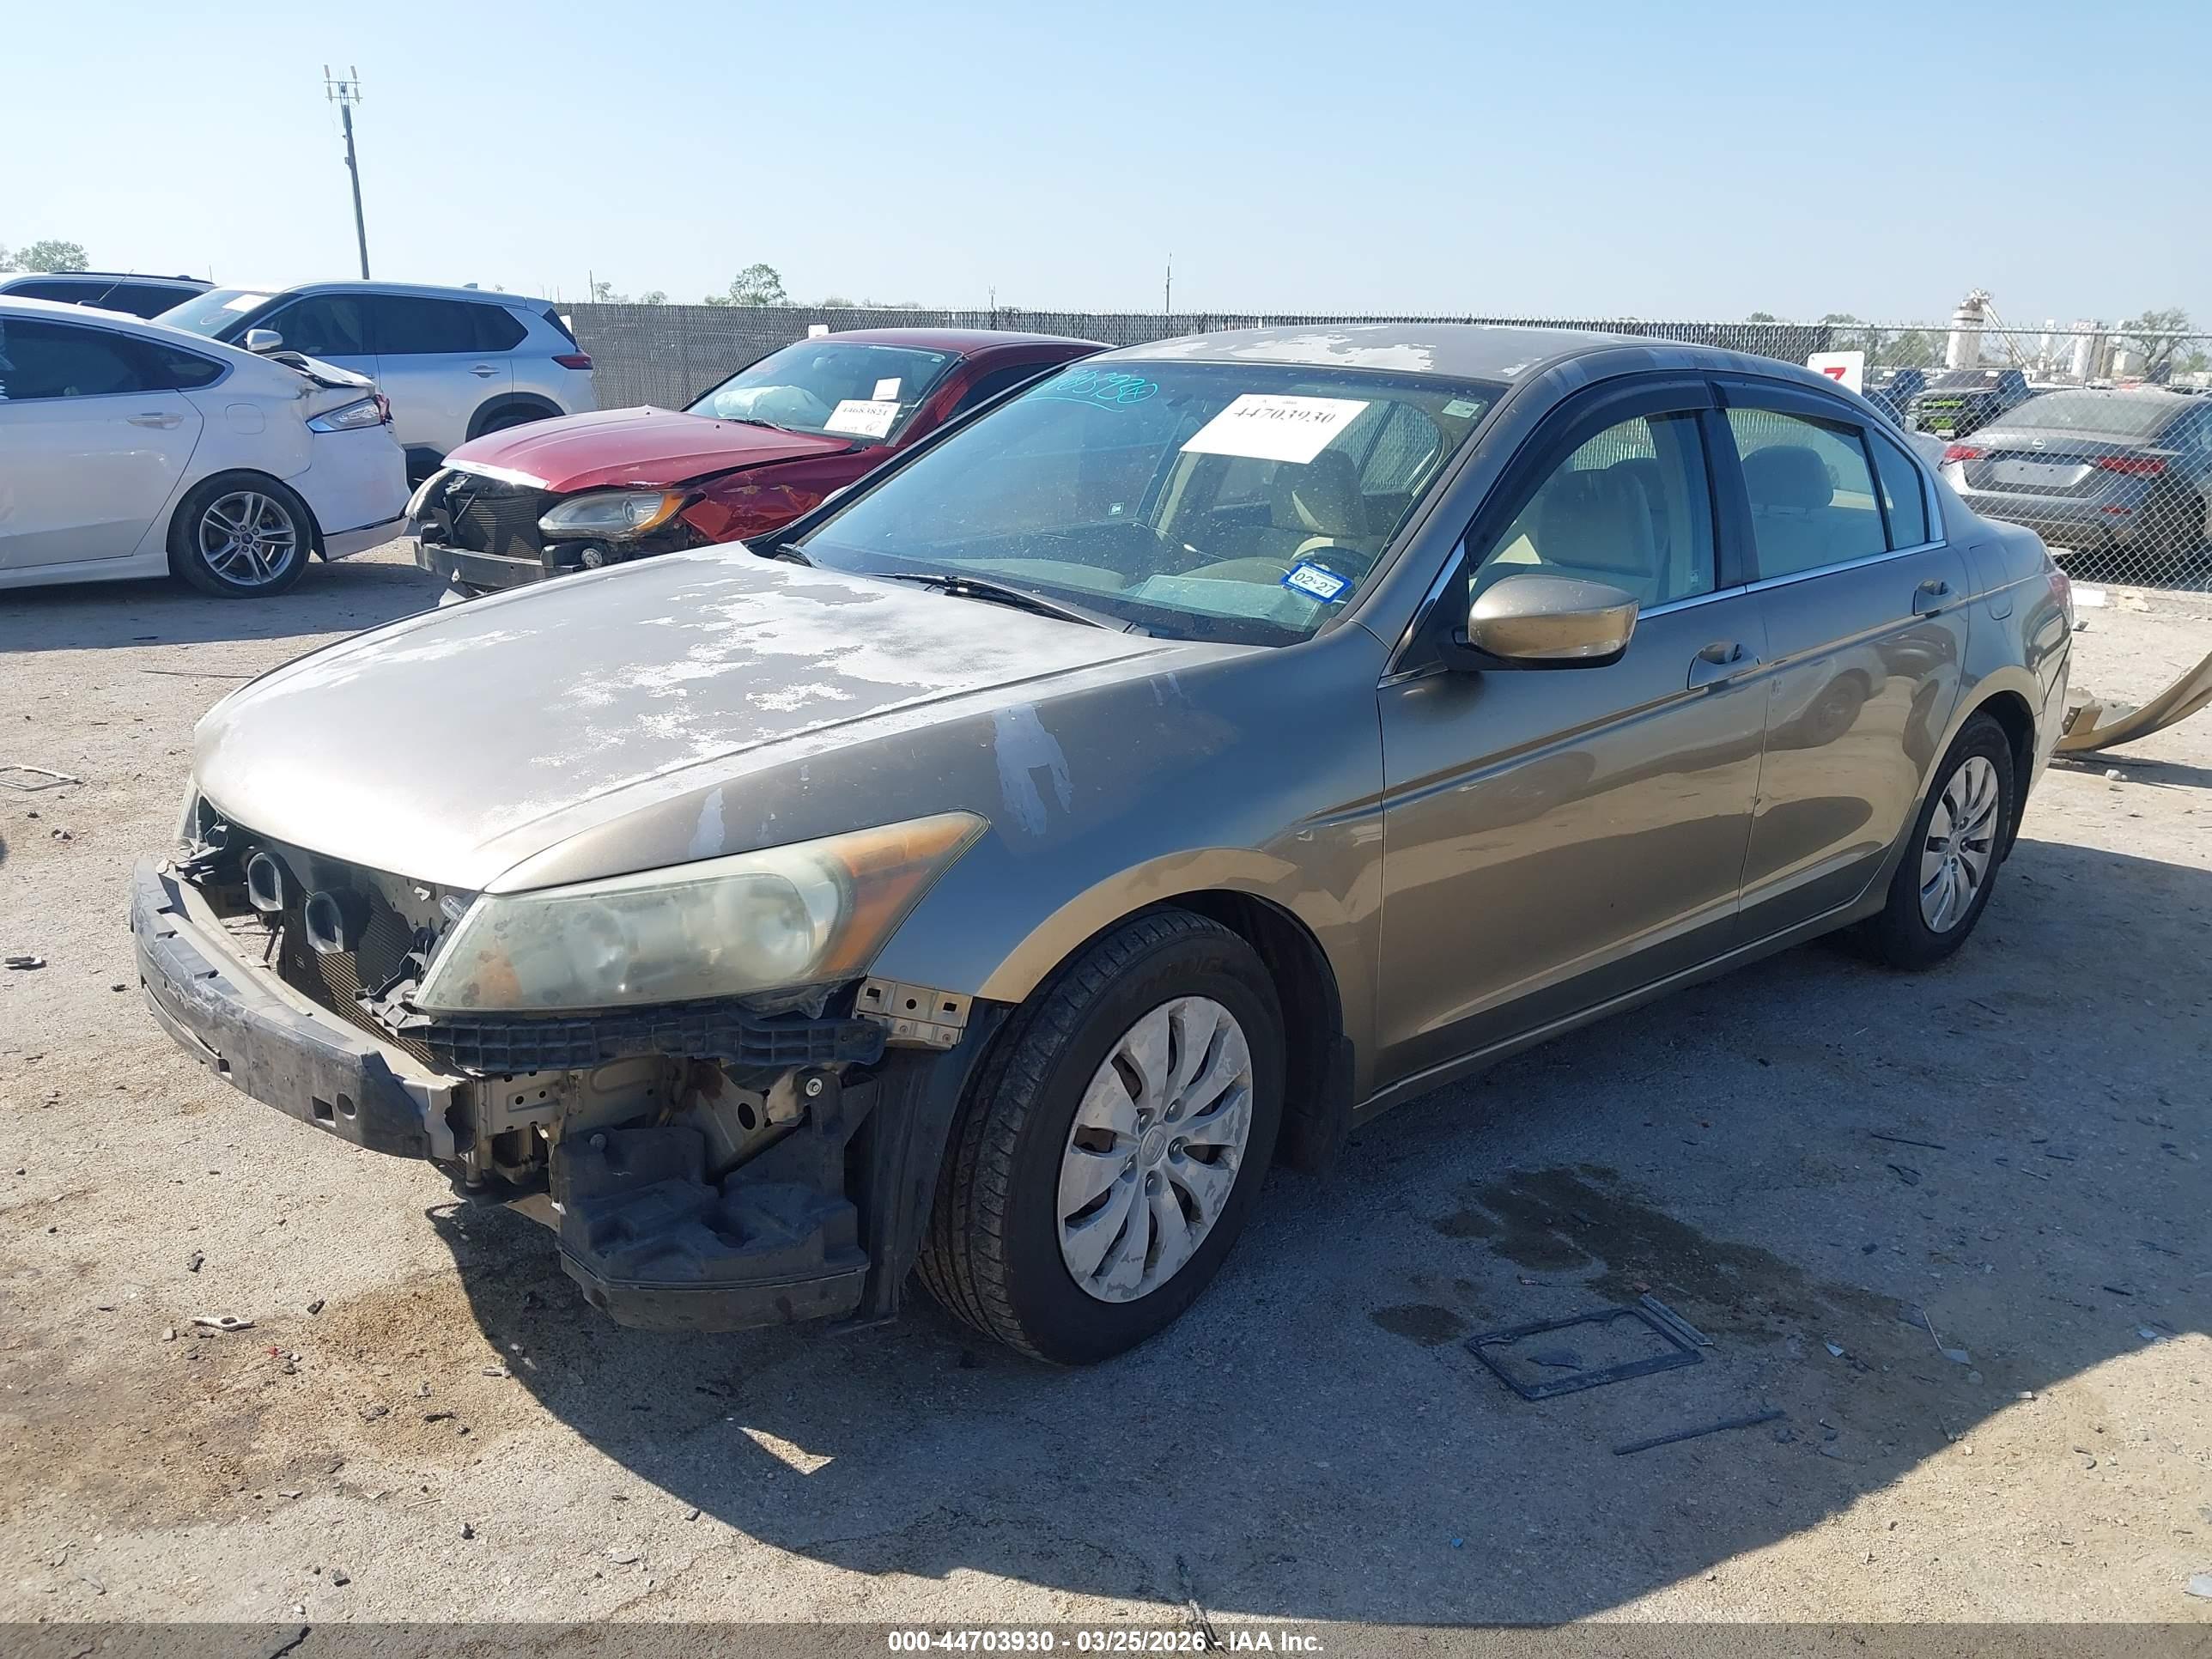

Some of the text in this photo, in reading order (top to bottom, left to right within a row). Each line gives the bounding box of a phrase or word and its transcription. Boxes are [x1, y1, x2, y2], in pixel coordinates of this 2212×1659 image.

[1233, 407, 1336, 424] 44703930
[1294, 572, 1315, 586] 02
[1315, 581, 1337, 593] 27
